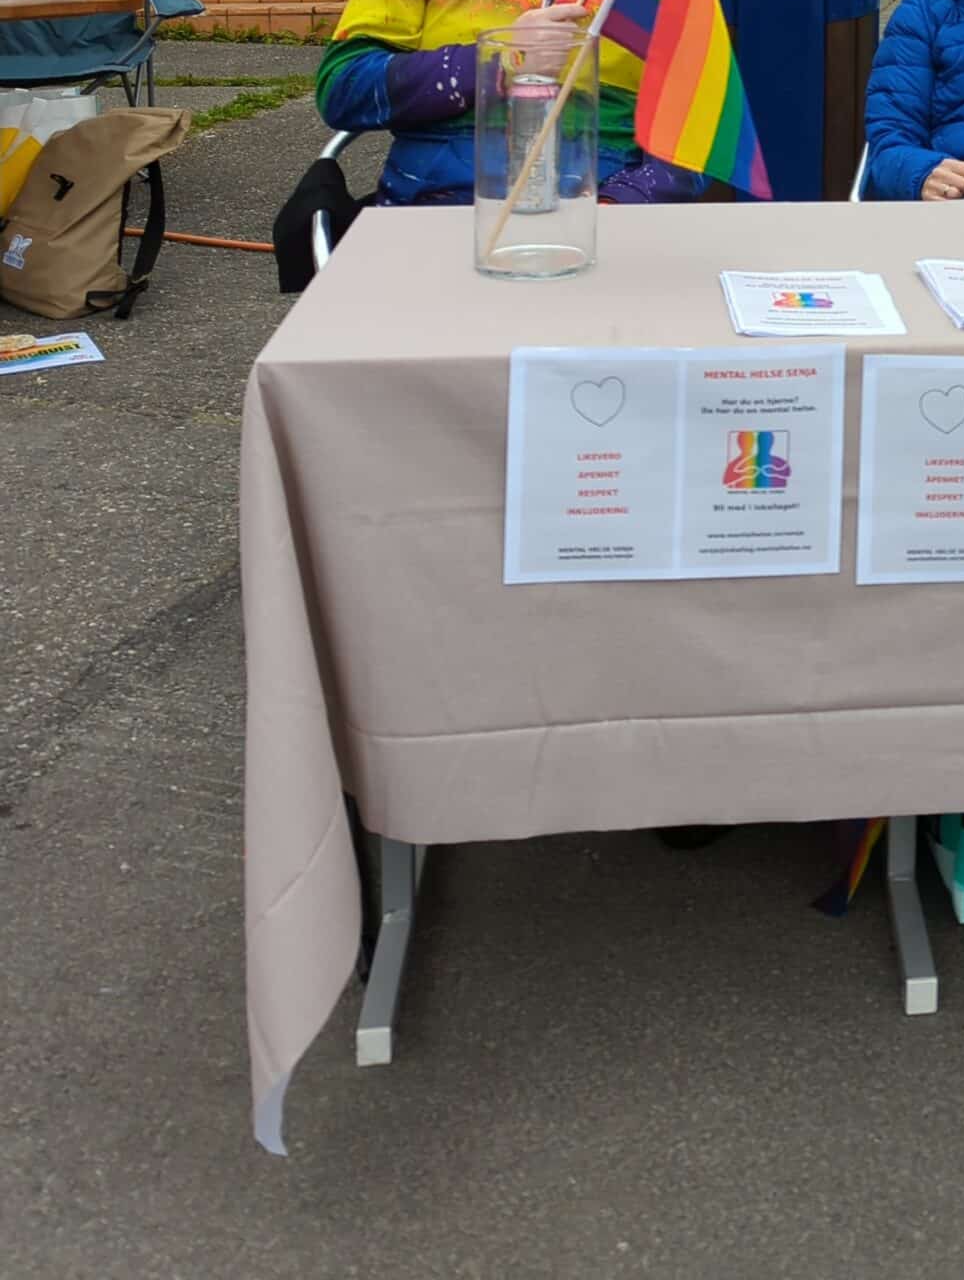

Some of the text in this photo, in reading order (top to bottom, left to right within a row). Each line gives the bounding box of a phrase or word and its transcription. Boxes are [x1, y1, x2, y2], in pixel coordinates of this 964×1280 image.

[703, 368, 817, 380] MENTAL HELSE SENJA
